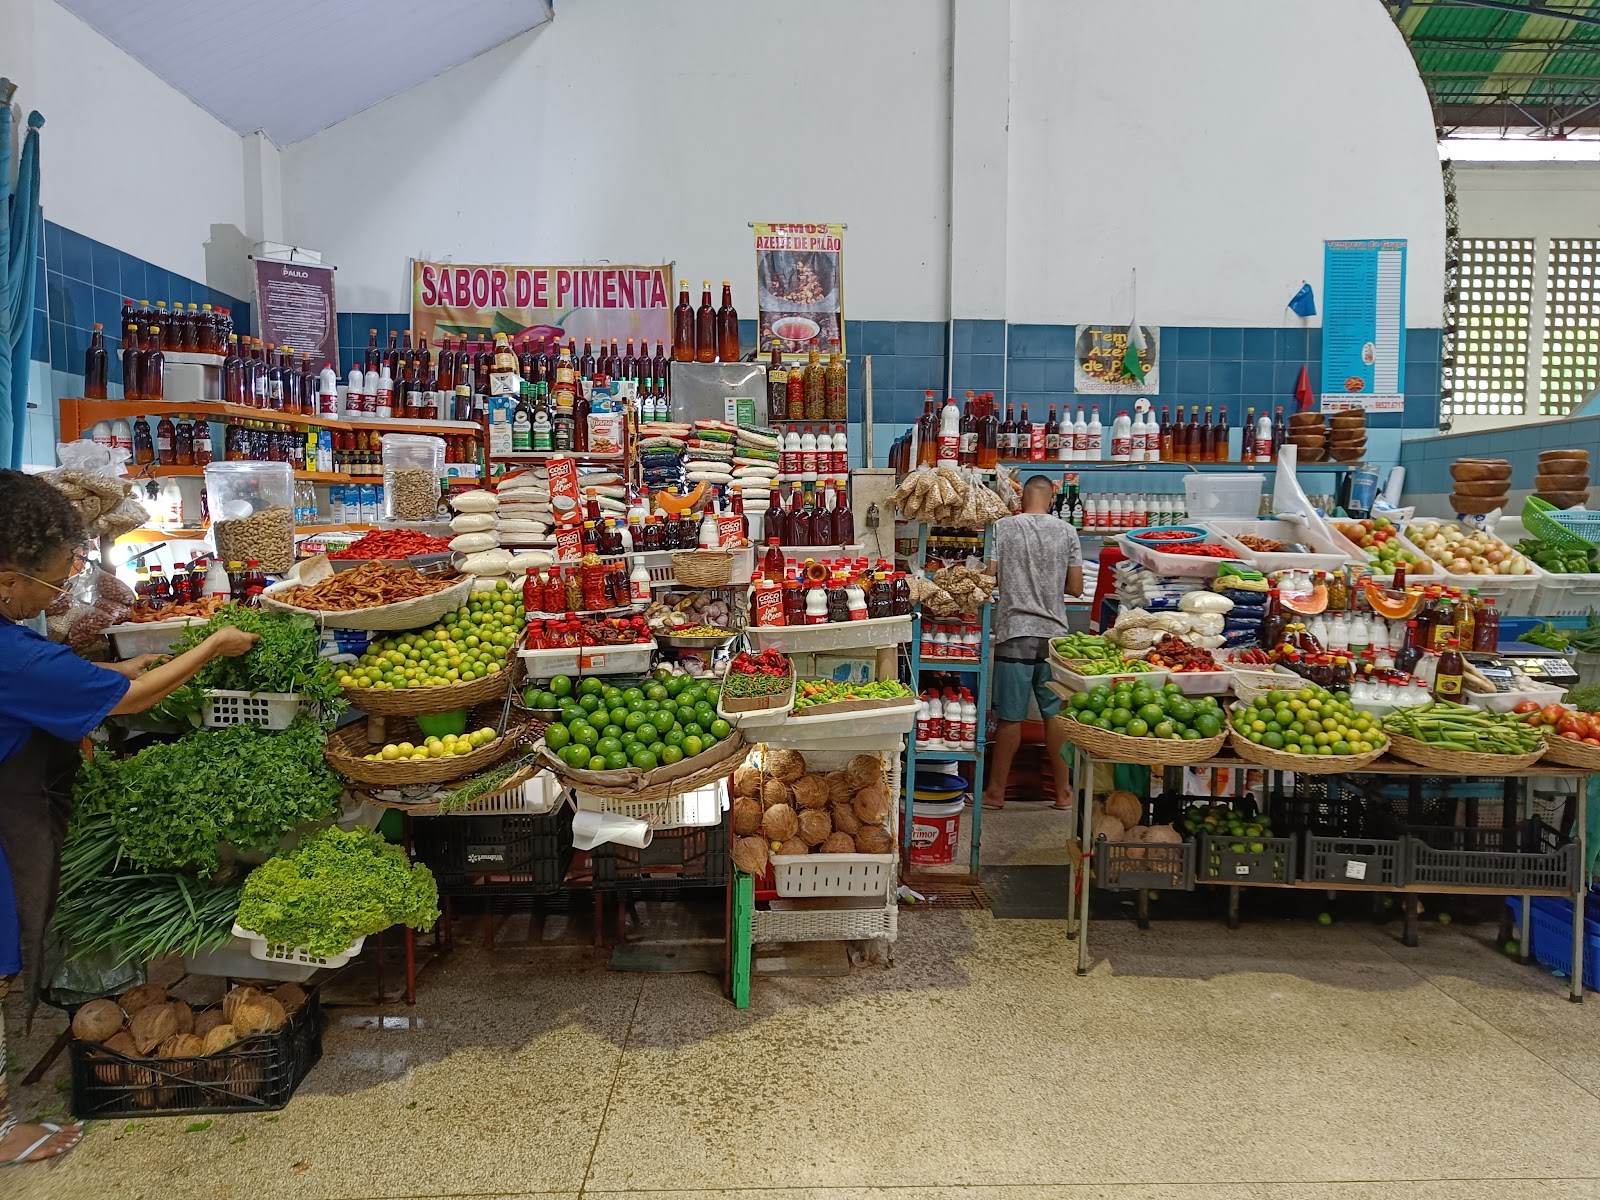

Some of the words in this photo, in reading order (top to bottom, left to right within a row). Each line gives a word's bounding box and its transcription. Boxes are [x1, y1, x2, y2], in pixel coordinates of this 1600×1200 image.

[768, 223, 829, 234] TEMOS
[756, 236, 792, 250] AZEITE
[794, 237, 808, 250] DE
[810, 236, 841, 251] PILÃO
[283, 270, 309, 279] PAULO
[422, 266, 508, 308] SABOR
[515, 269, 549, 309] DE
[556, 270, 668, 309] PIMENTA
[1088, 345, 1147, 357] Azeie
[550, 464, 568, 473] COCO
[720, 522, 739, 530] COCO
[558, 533, 577, 542] COCO
[759, 593, 779, 601] COCO
[768, 612, 782, 621] Coco
[912, 828, 937, 838] rimor
